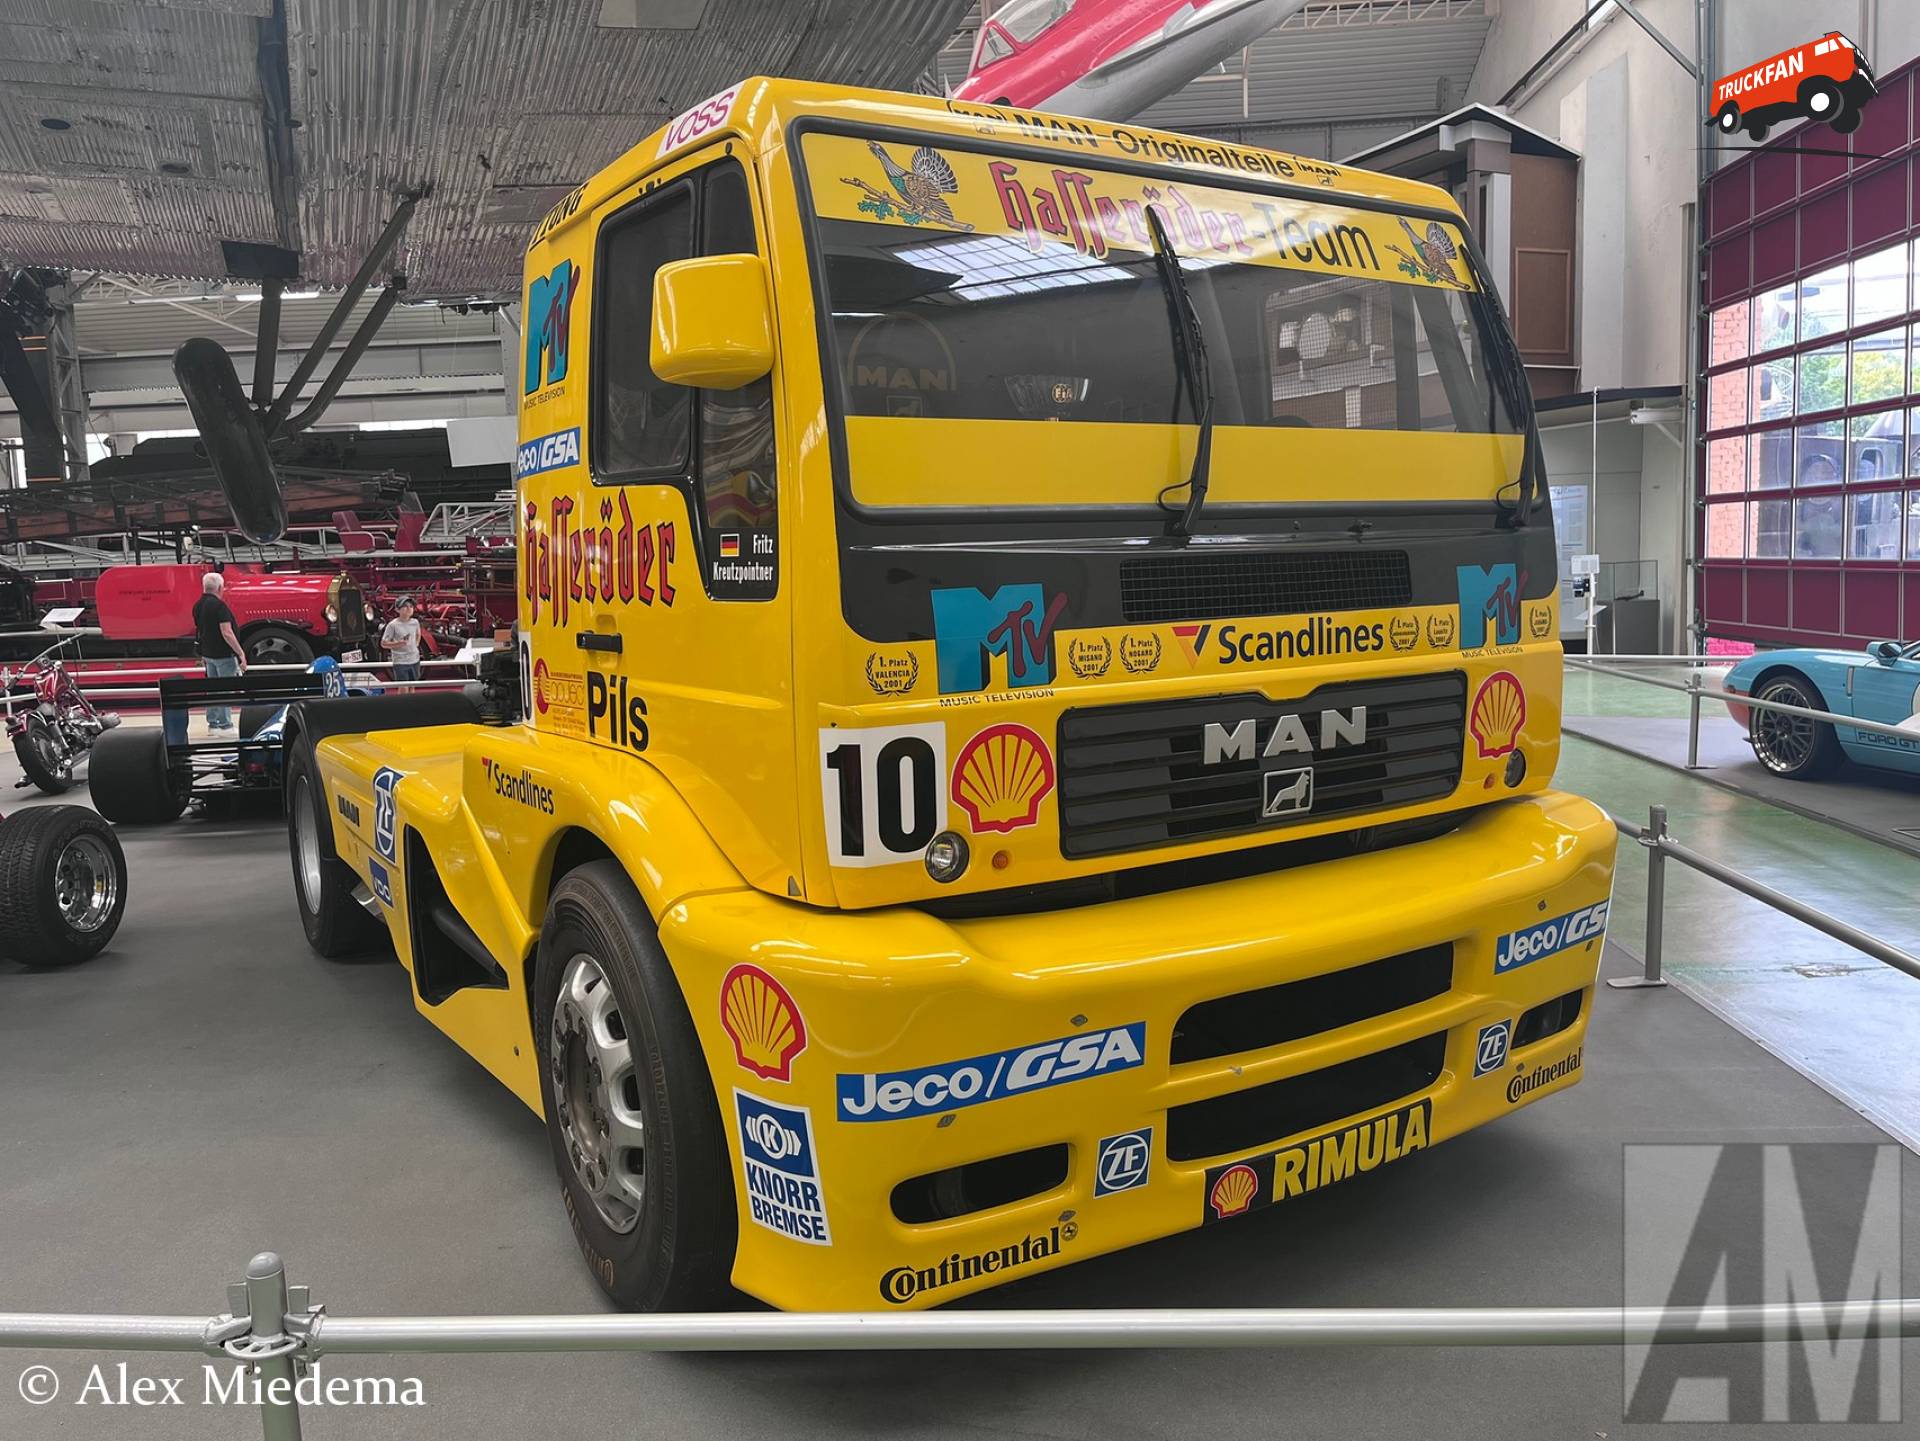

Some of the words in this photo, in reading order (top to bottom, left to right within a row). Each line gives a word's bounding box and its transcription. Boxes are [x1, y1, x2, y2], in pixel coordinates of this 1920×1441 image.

[664, 91, 735, 152] VOSS
[1301, 164, 1340, 177] MAN
[524, 258, 581, 394] MTV
[857, 366, 949, 391] MAN
[517, 431, 579, 474] eco/GSA
[752, 534, 774, 554] Fritz
[712, 561, 774, 584] Kreutzpointner
[1456, 563, 1528, 650] MTV
[879, 656, 887, 667] 1.
[888, 658, 908, 667] Platz
[930, 583, 1068, 695] MTV
[1087, 644, 1104, 652] Platz
[1138, 640, 1153, 648] Platz
[1219, 616, 1384, 665] Scandlines
[1462, 649, 1484, 658] MUSIC
[1486, 645, 1524, 656] TELEVISION
[325, 671, 341, 699] 25
[875, 670, 911, 679] VALENCIA
[884, 680, 903, 688] 2001
[587, 671, 649, 752] Pils
[939, 695, 981, 708] MUSIC
[983, 688, 1055, 703] TELEVISION
[1203, 706, 1367, 765] MAN
[1858, 732, 1897, 746] FORD
[1900, 738, 1919, 749] GT
[495, 763, 555, 816] Scandlines
[826, 737, 938, 857] 10
[1498, 902, 1609, 968] Jeco/GS
[1481, 1032, 1508, 1062] ZF
[842, 1028, 1142, 1115] Jeco/GSA
[1507, 1047, 1582, 1104] Continental
[1103, 1140, 1148, 1179] ZF
[1272, 1104, 1428, 1203] RIMULA
[746, 1162, 821, 1212] KNORR
[752, 1194, 827, 1242] BREMSE
[880, 1227, 1061, 1304] Continental
